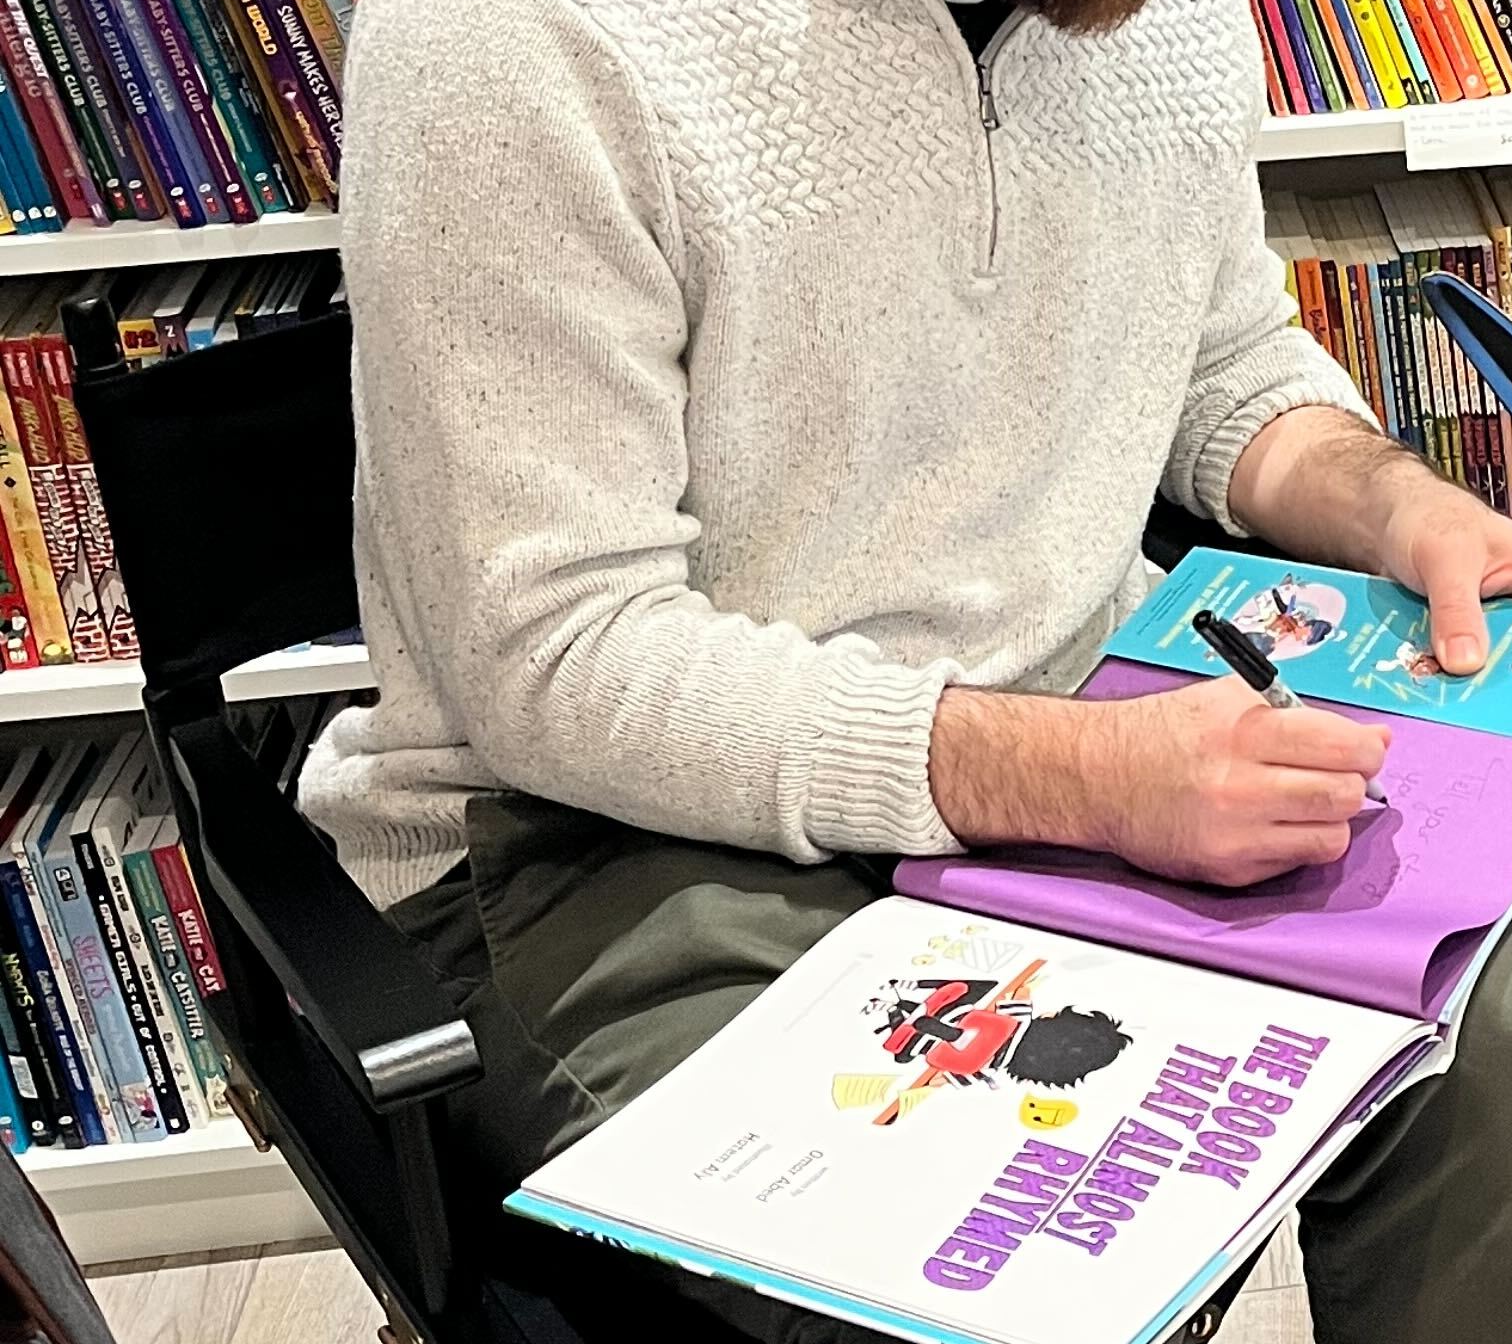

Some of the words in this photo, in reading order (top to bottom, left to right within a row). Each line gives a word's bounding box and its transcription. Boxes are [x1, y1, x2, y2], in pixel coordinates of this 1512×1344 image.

[244, 2, 280, 57] WORLD
[62, 73, 86, 107] CLUB
[124, 80, 149, 115] CLUB
[180, 77, 205, 112] CLUB
[150, 913, 174, 953] KATIE
[178, 908, 202, 949] KATIE
[1243, 1024, 1330, 1089] THE
[1139, 1043, 1237, 1131] THAT
[716, 1129, 758, 1166] Hatem
[1178, 1081, 1294, 1191] BOOK
[694, 1160, 719, 1184] Aly
[787, 1146, 822, 1178] Omar
[755, 1172, 790, 1206] Abed
[1043, 1117, 1184, 1257] ALMOST
[921, 1137, 1089, 1292] RHYMED
